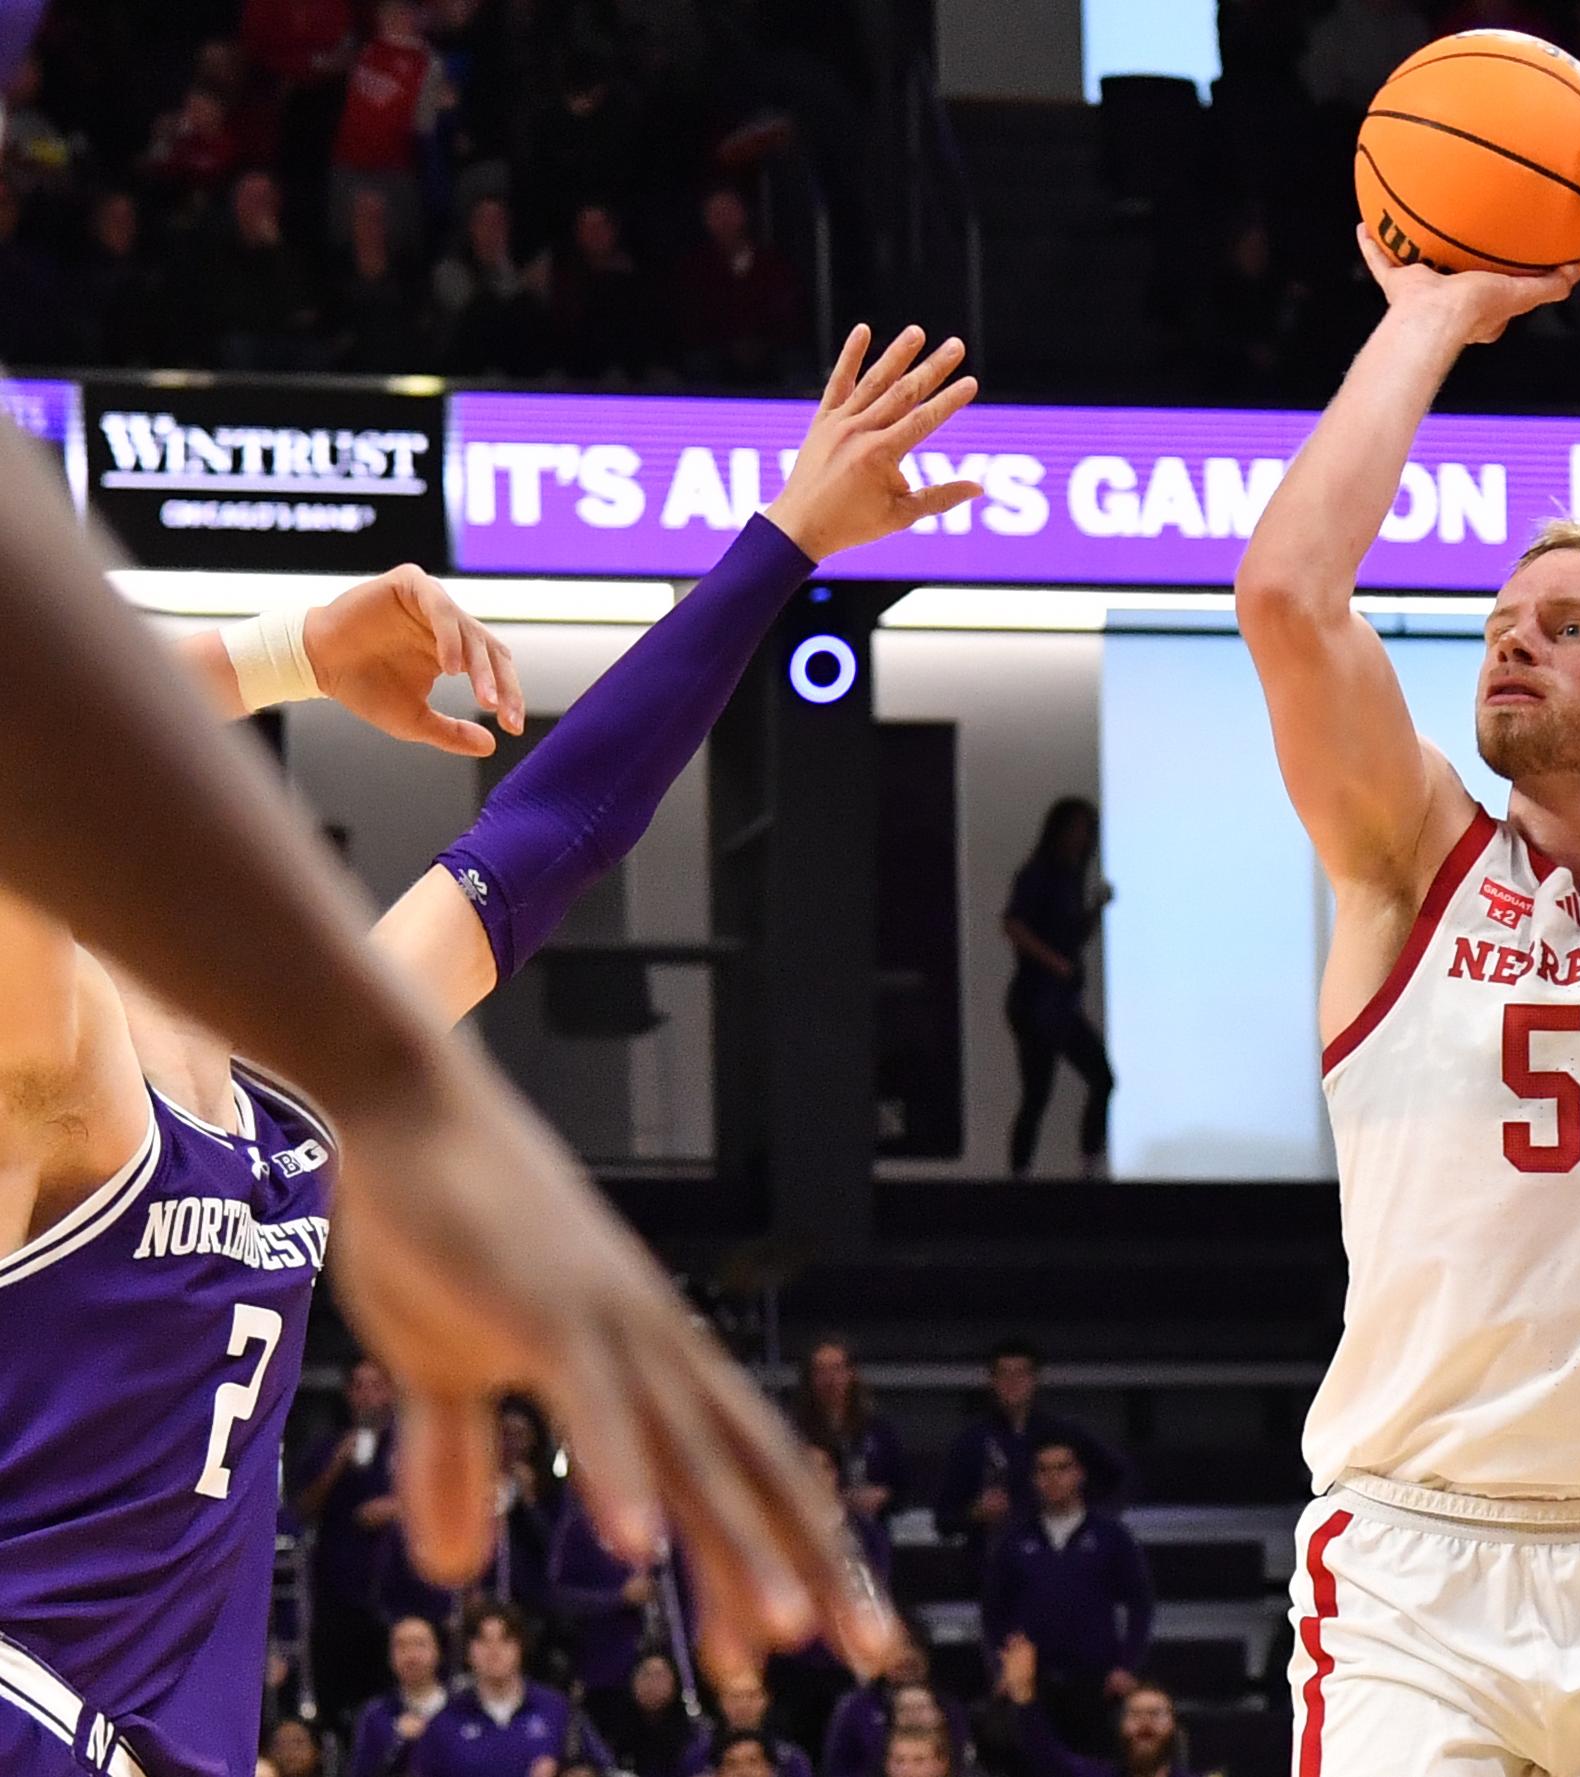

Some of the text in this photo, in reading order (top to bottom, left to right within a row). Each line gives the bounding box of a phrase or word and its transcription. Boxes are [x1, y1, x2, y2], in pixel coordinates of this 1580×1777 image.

[100, 411, 429, 478] WINTRUST
[464, 441, 1508, 545] IT'S ALYS GAM ON
[1483, 884, 1533, 912] GRADUAT
[195, 1303, 282, 1499] 2
